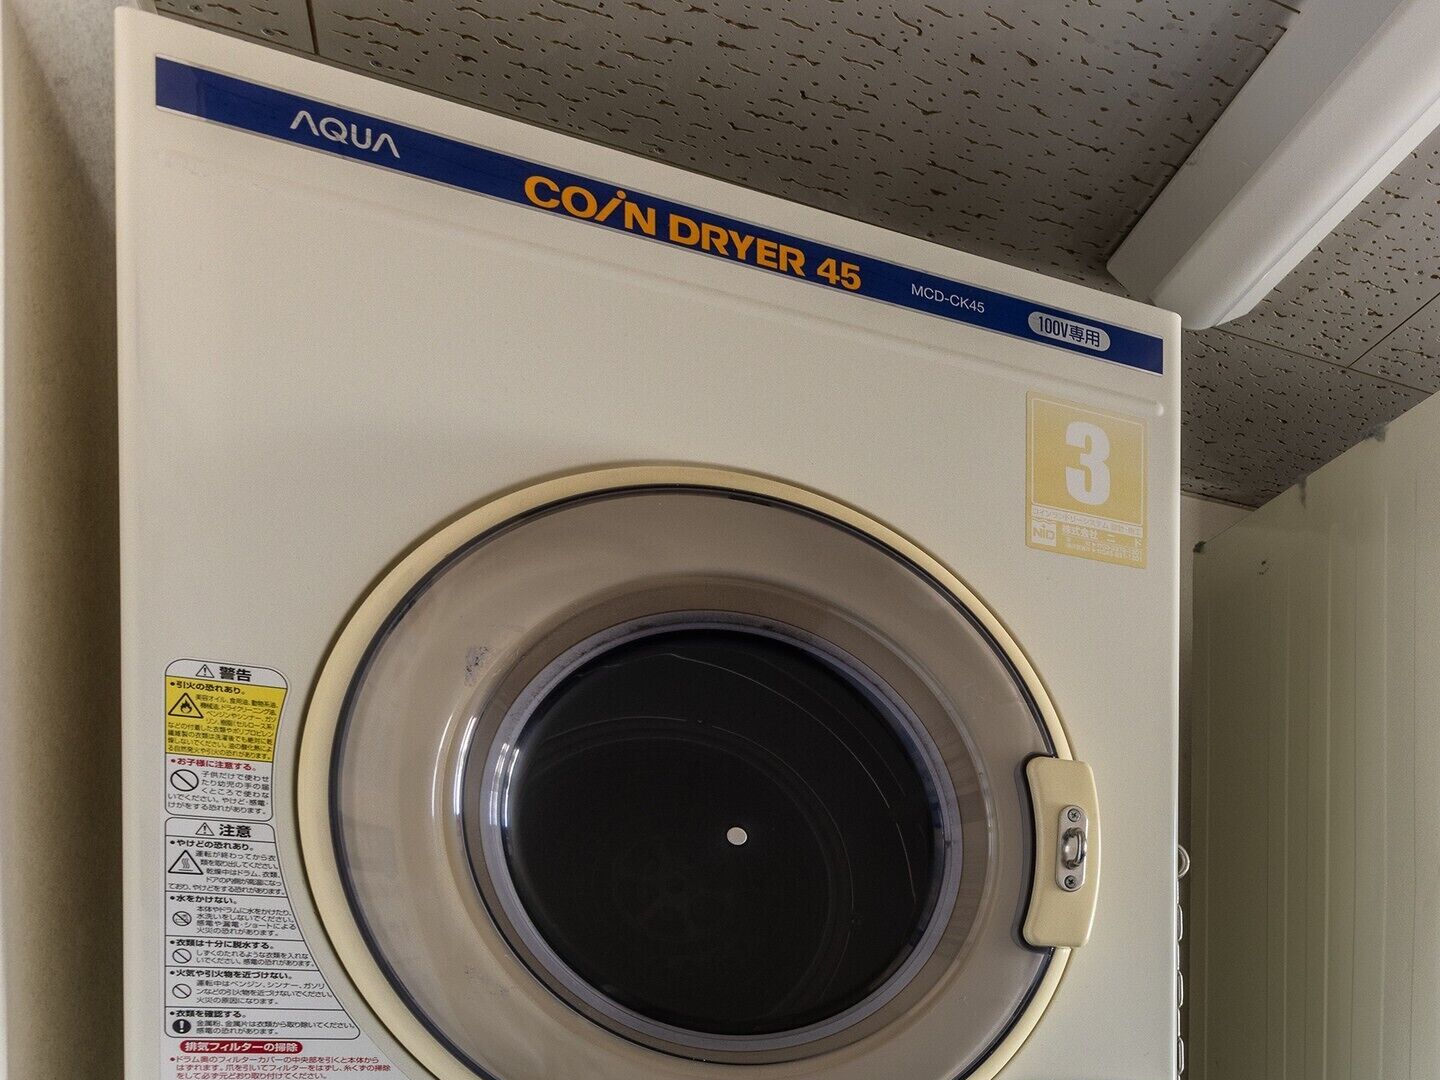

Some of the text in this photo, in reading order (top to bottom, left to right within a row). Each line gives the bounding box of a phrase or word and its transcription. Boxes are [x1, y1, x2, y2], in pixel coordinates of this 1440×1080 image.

[290, 110, 986, 314] AQUA COIN DRYER 45 MCD-CK45
[1037, 316, 1101, 348] 100V専用
[1065, 421, 1112, 507] 3
[219, 666, 252, 682] 警告
[219, 824, 251, 838] 注意
[185, 1041, 298, 1053] 排気フィルターの掃除
